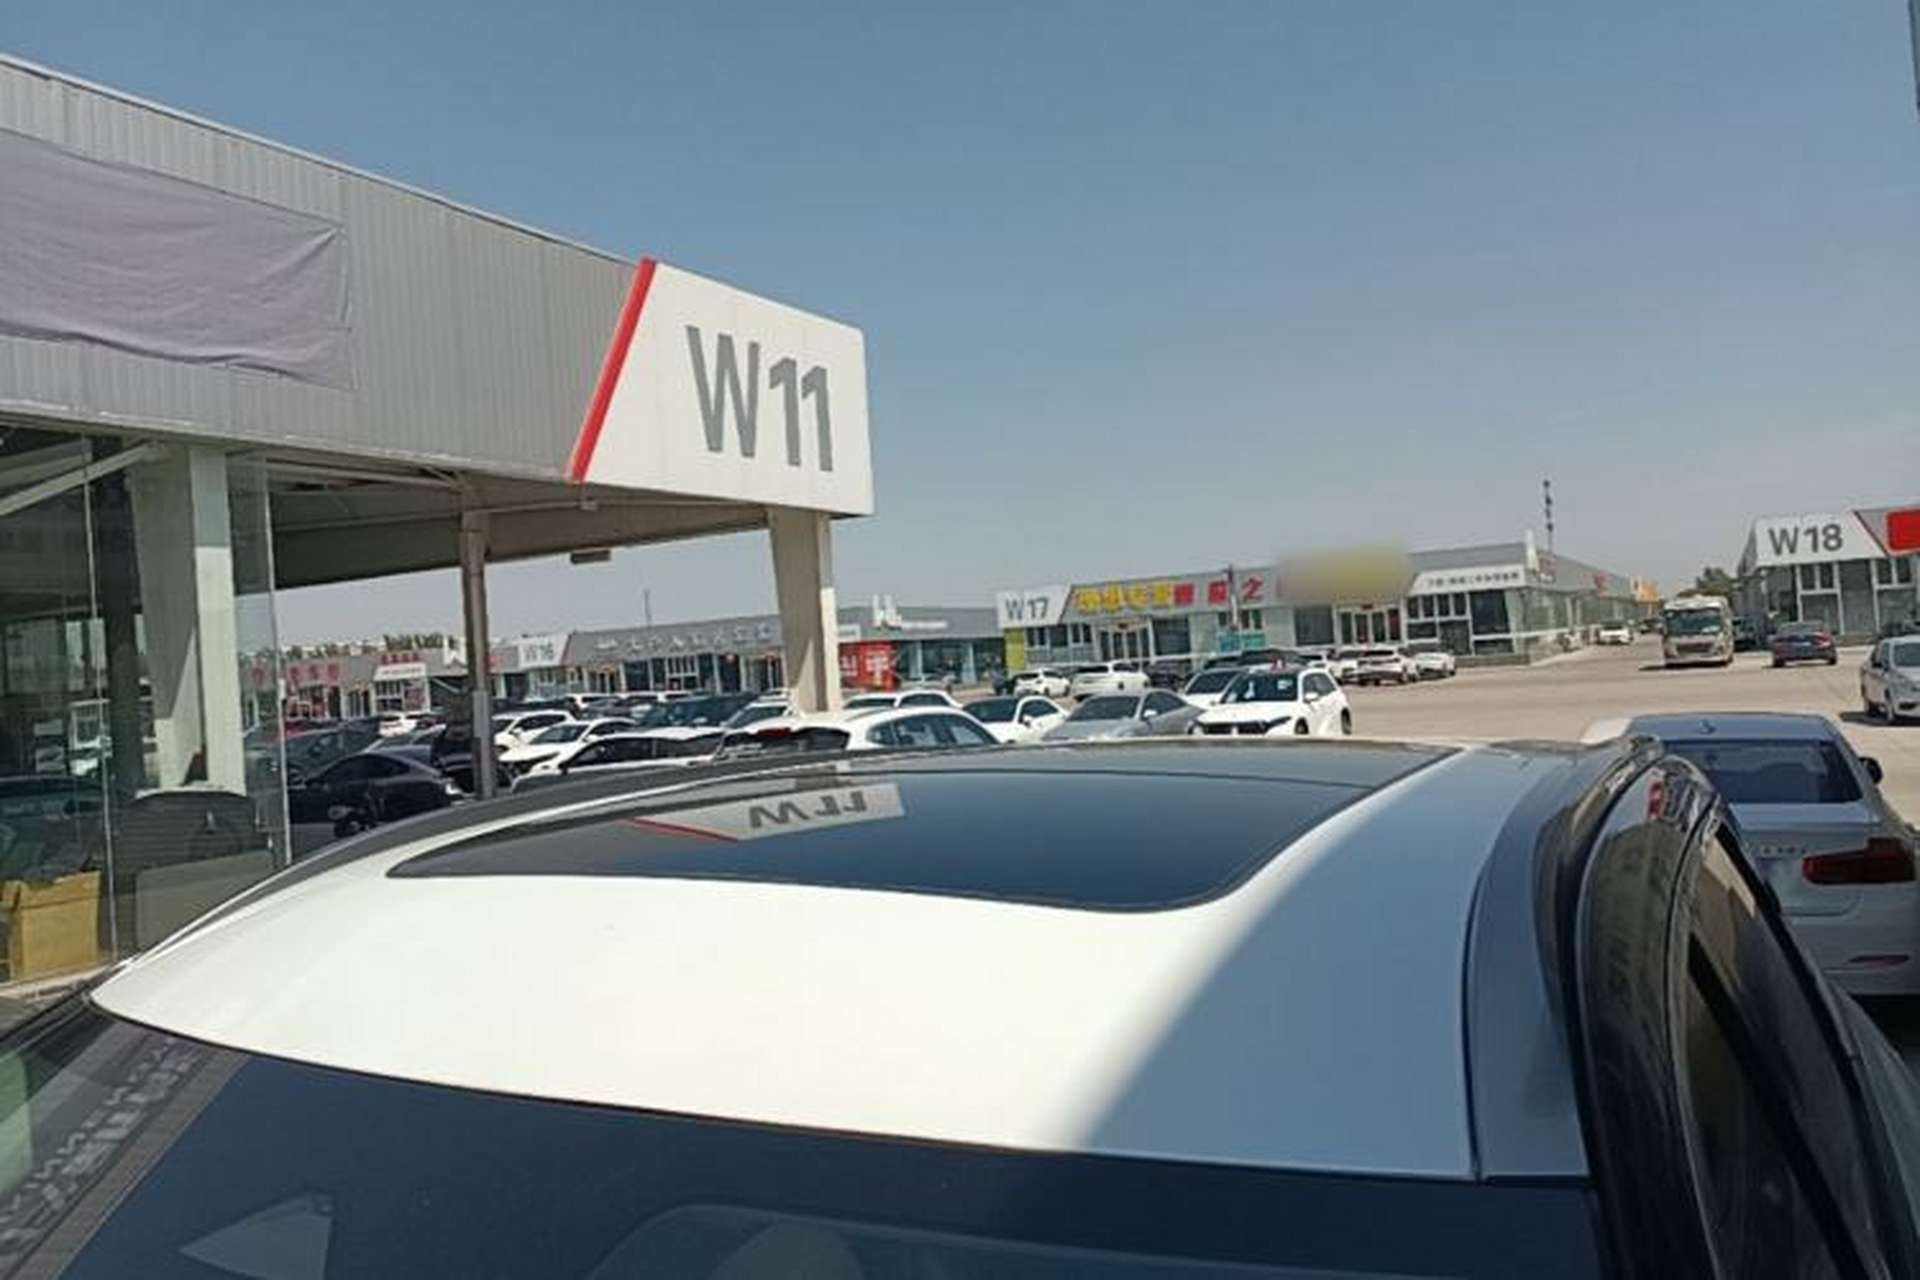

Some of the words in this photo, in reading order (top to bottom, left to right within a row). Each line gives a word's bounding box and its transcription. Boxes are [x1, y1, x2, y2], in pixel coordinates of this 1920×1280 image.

[685, 324, 833, 473] W11
[1768, 524, 1844, 556] W18
[1005, 596, 1049, 620] W17
